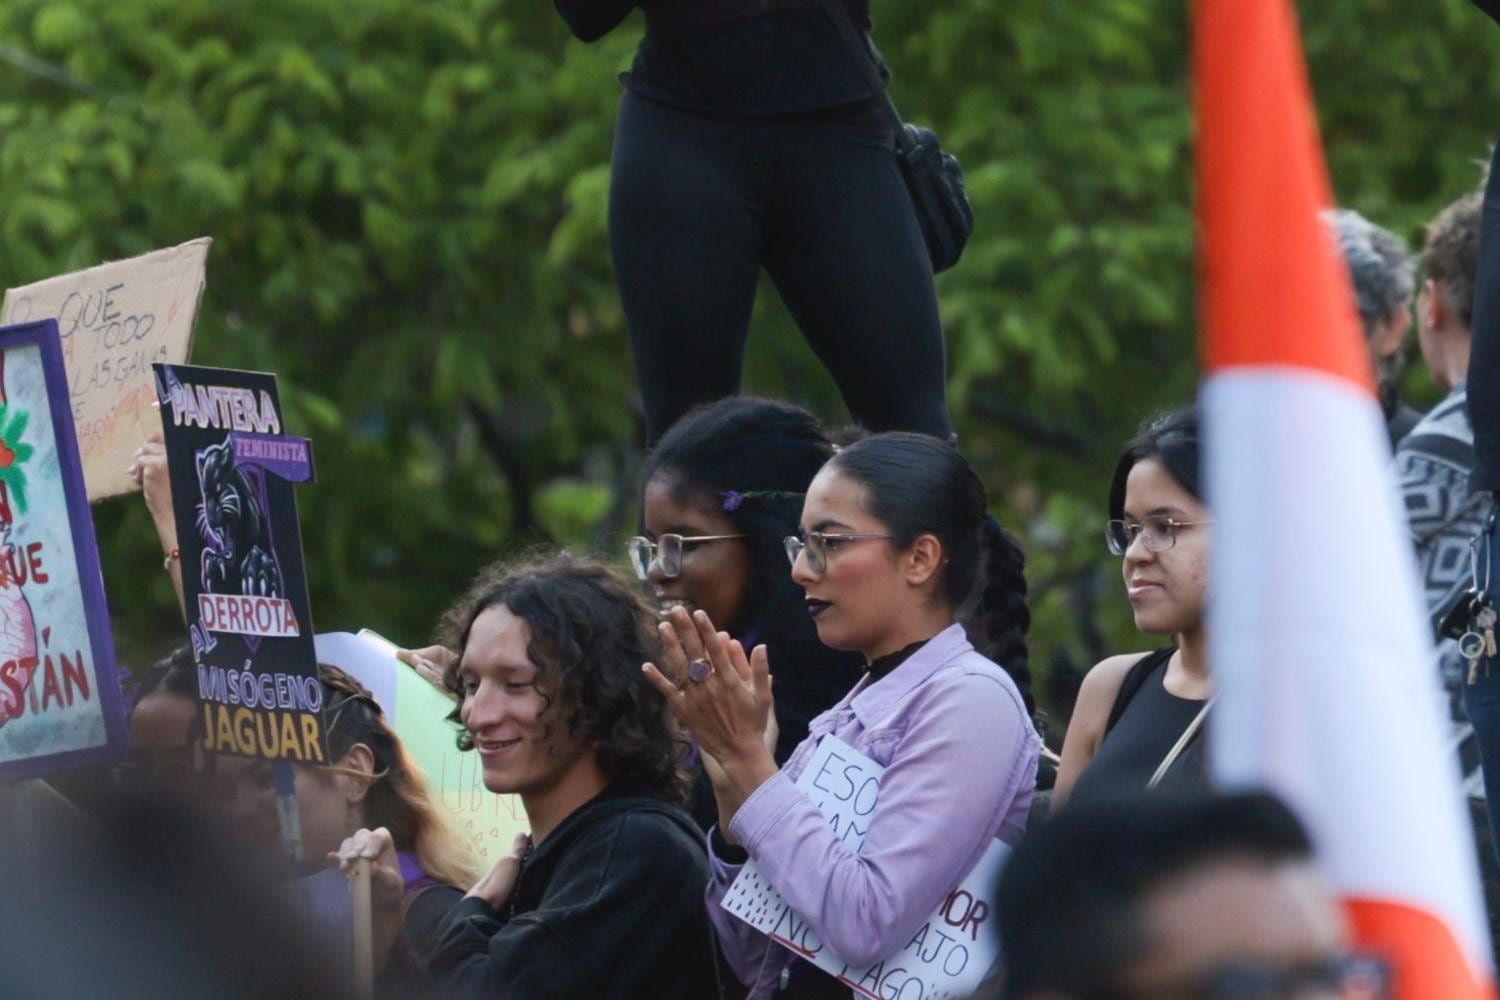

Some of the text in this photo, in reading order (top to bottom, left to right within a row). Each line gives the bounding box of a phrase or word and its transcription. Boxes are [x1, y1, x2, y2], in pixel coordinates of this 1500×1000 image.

[94, 314, 155, 351] TODO
[171, 382, 281, 436] PANTERA
[236, 438, 307, 463] FEMINISTA
[7, 542, 48, 586] UE
[190, 616, 218, 663] AL
[200, 595, 299, 634] DERROTA
[0, 626, 90, 720] STÁN
[197, 659, 322, 713] MISÓGENO
[203, 703, 324, 762] JAGUAR
[812, 751, 880, 816] ESO
